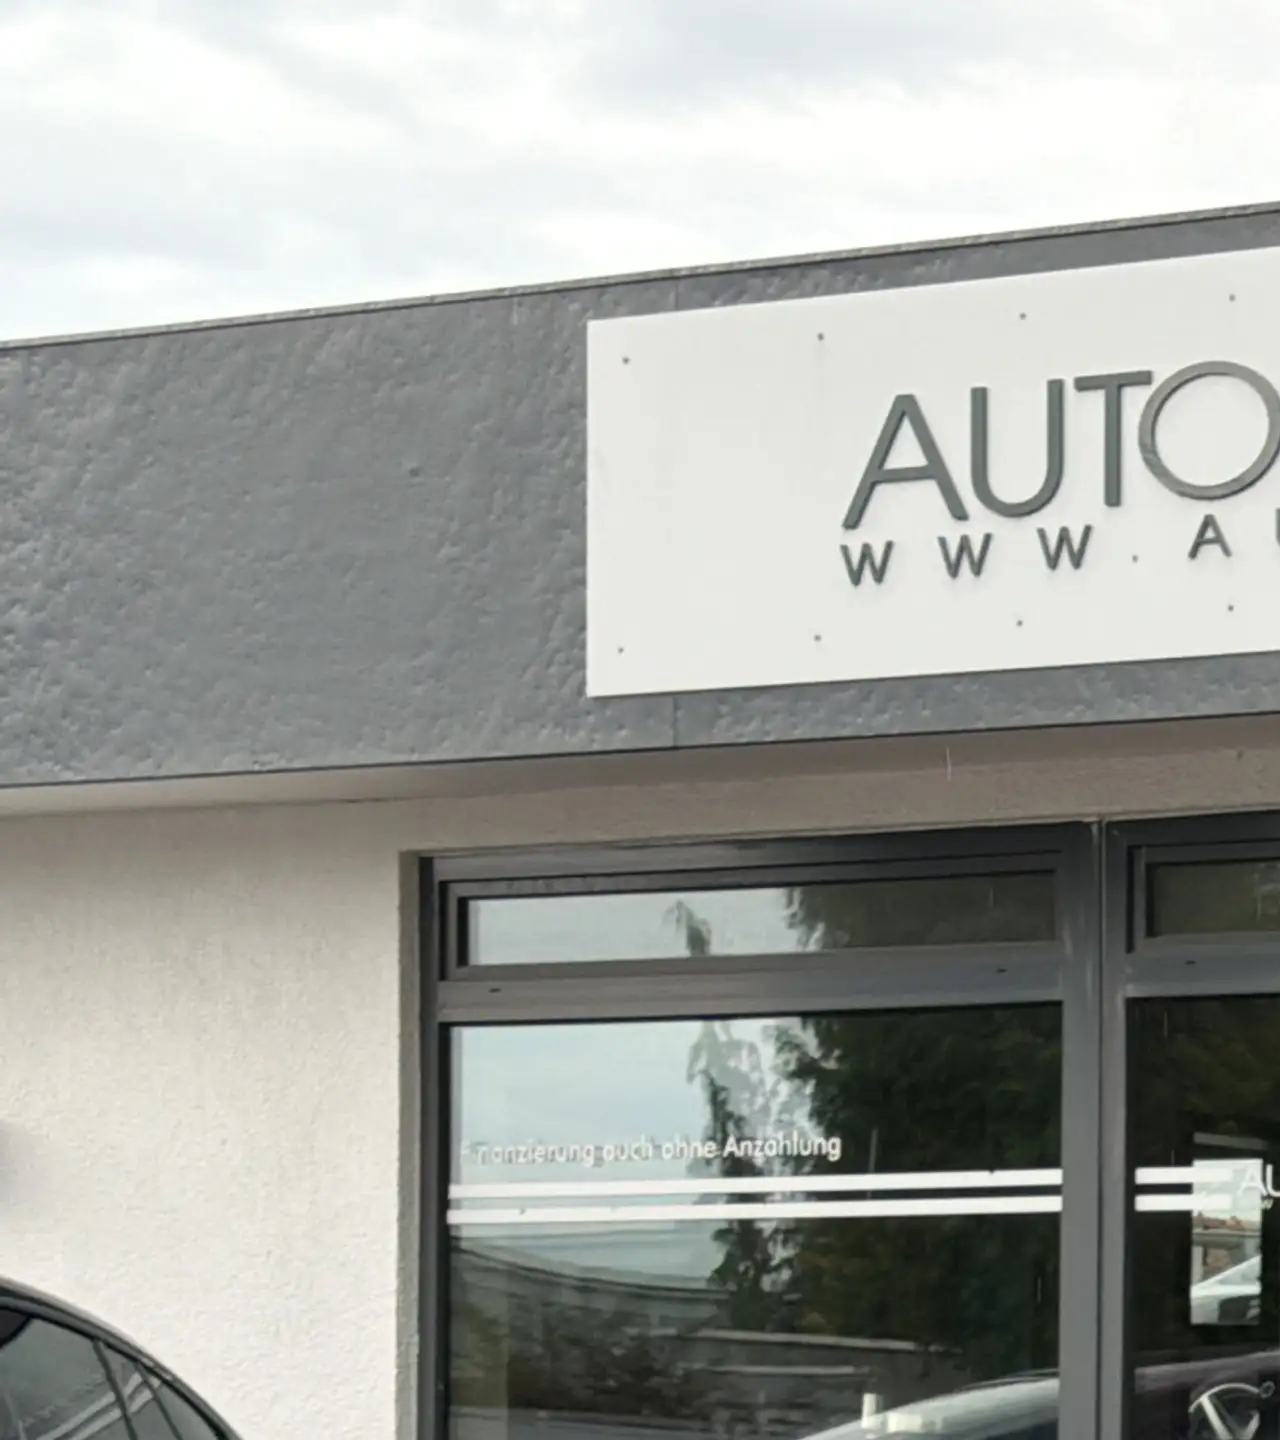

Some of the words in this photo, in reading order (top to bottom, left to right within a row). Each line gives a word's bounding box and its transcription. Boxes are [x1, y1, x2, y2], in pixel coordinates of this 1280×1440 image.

[602, 1134, 654, 1162] auch
[661, 1133, 718, 1159] ohne
[723, 1131, 843, 1163] Anzahlung
